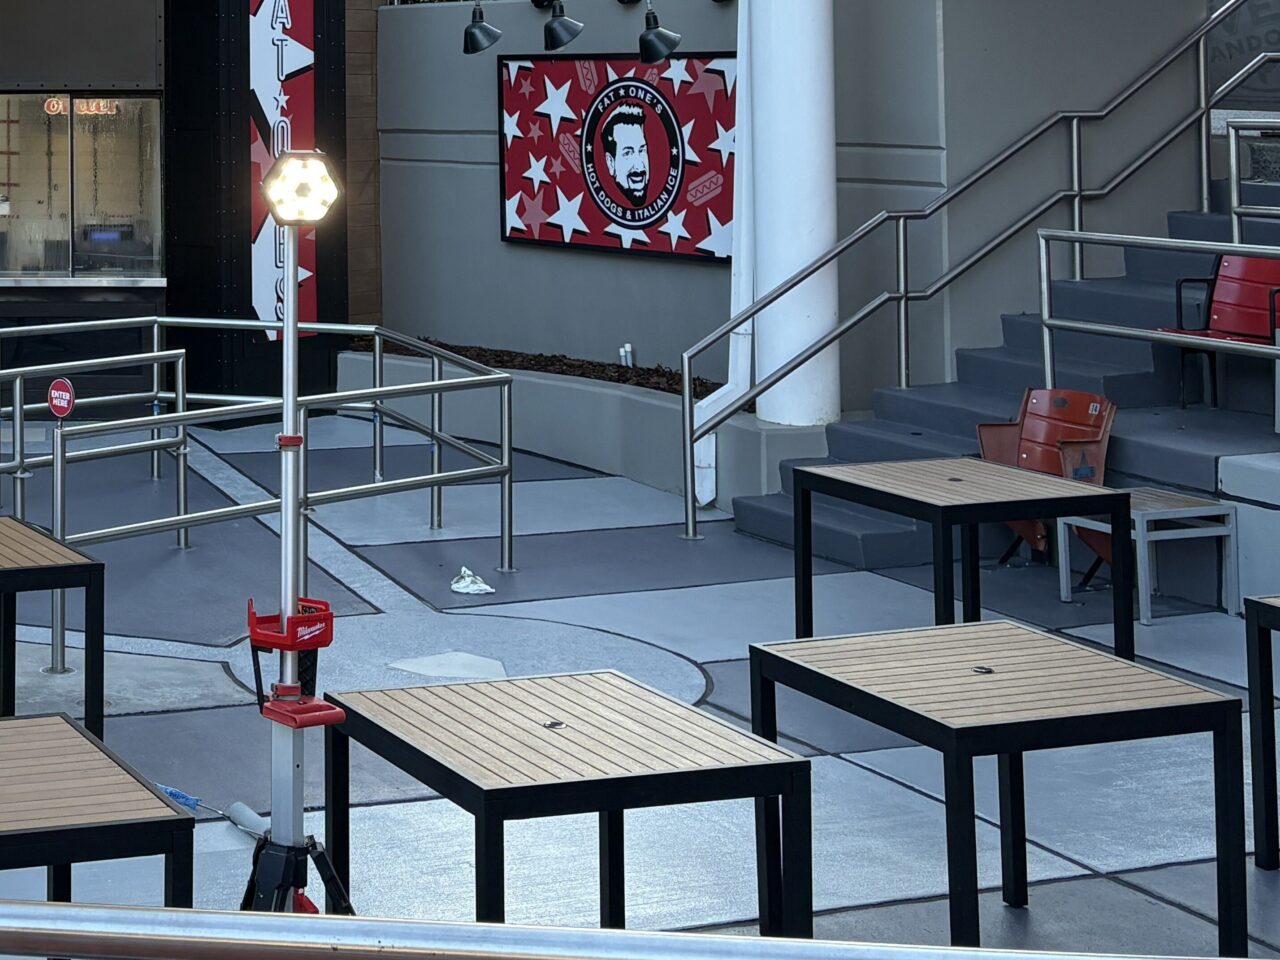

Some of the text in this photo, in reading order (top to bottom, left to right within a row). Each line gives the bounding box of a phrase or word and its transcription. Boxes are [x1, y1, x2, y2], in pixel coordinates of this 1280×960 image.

[597, 86, 663, 114] FAT ONE'S
[586, 163, 678, 220] HOT DOGS & ITALIAN ICE
[51, 389, 71, 401] ENTER
[52, 398, 69, 408] HERE
